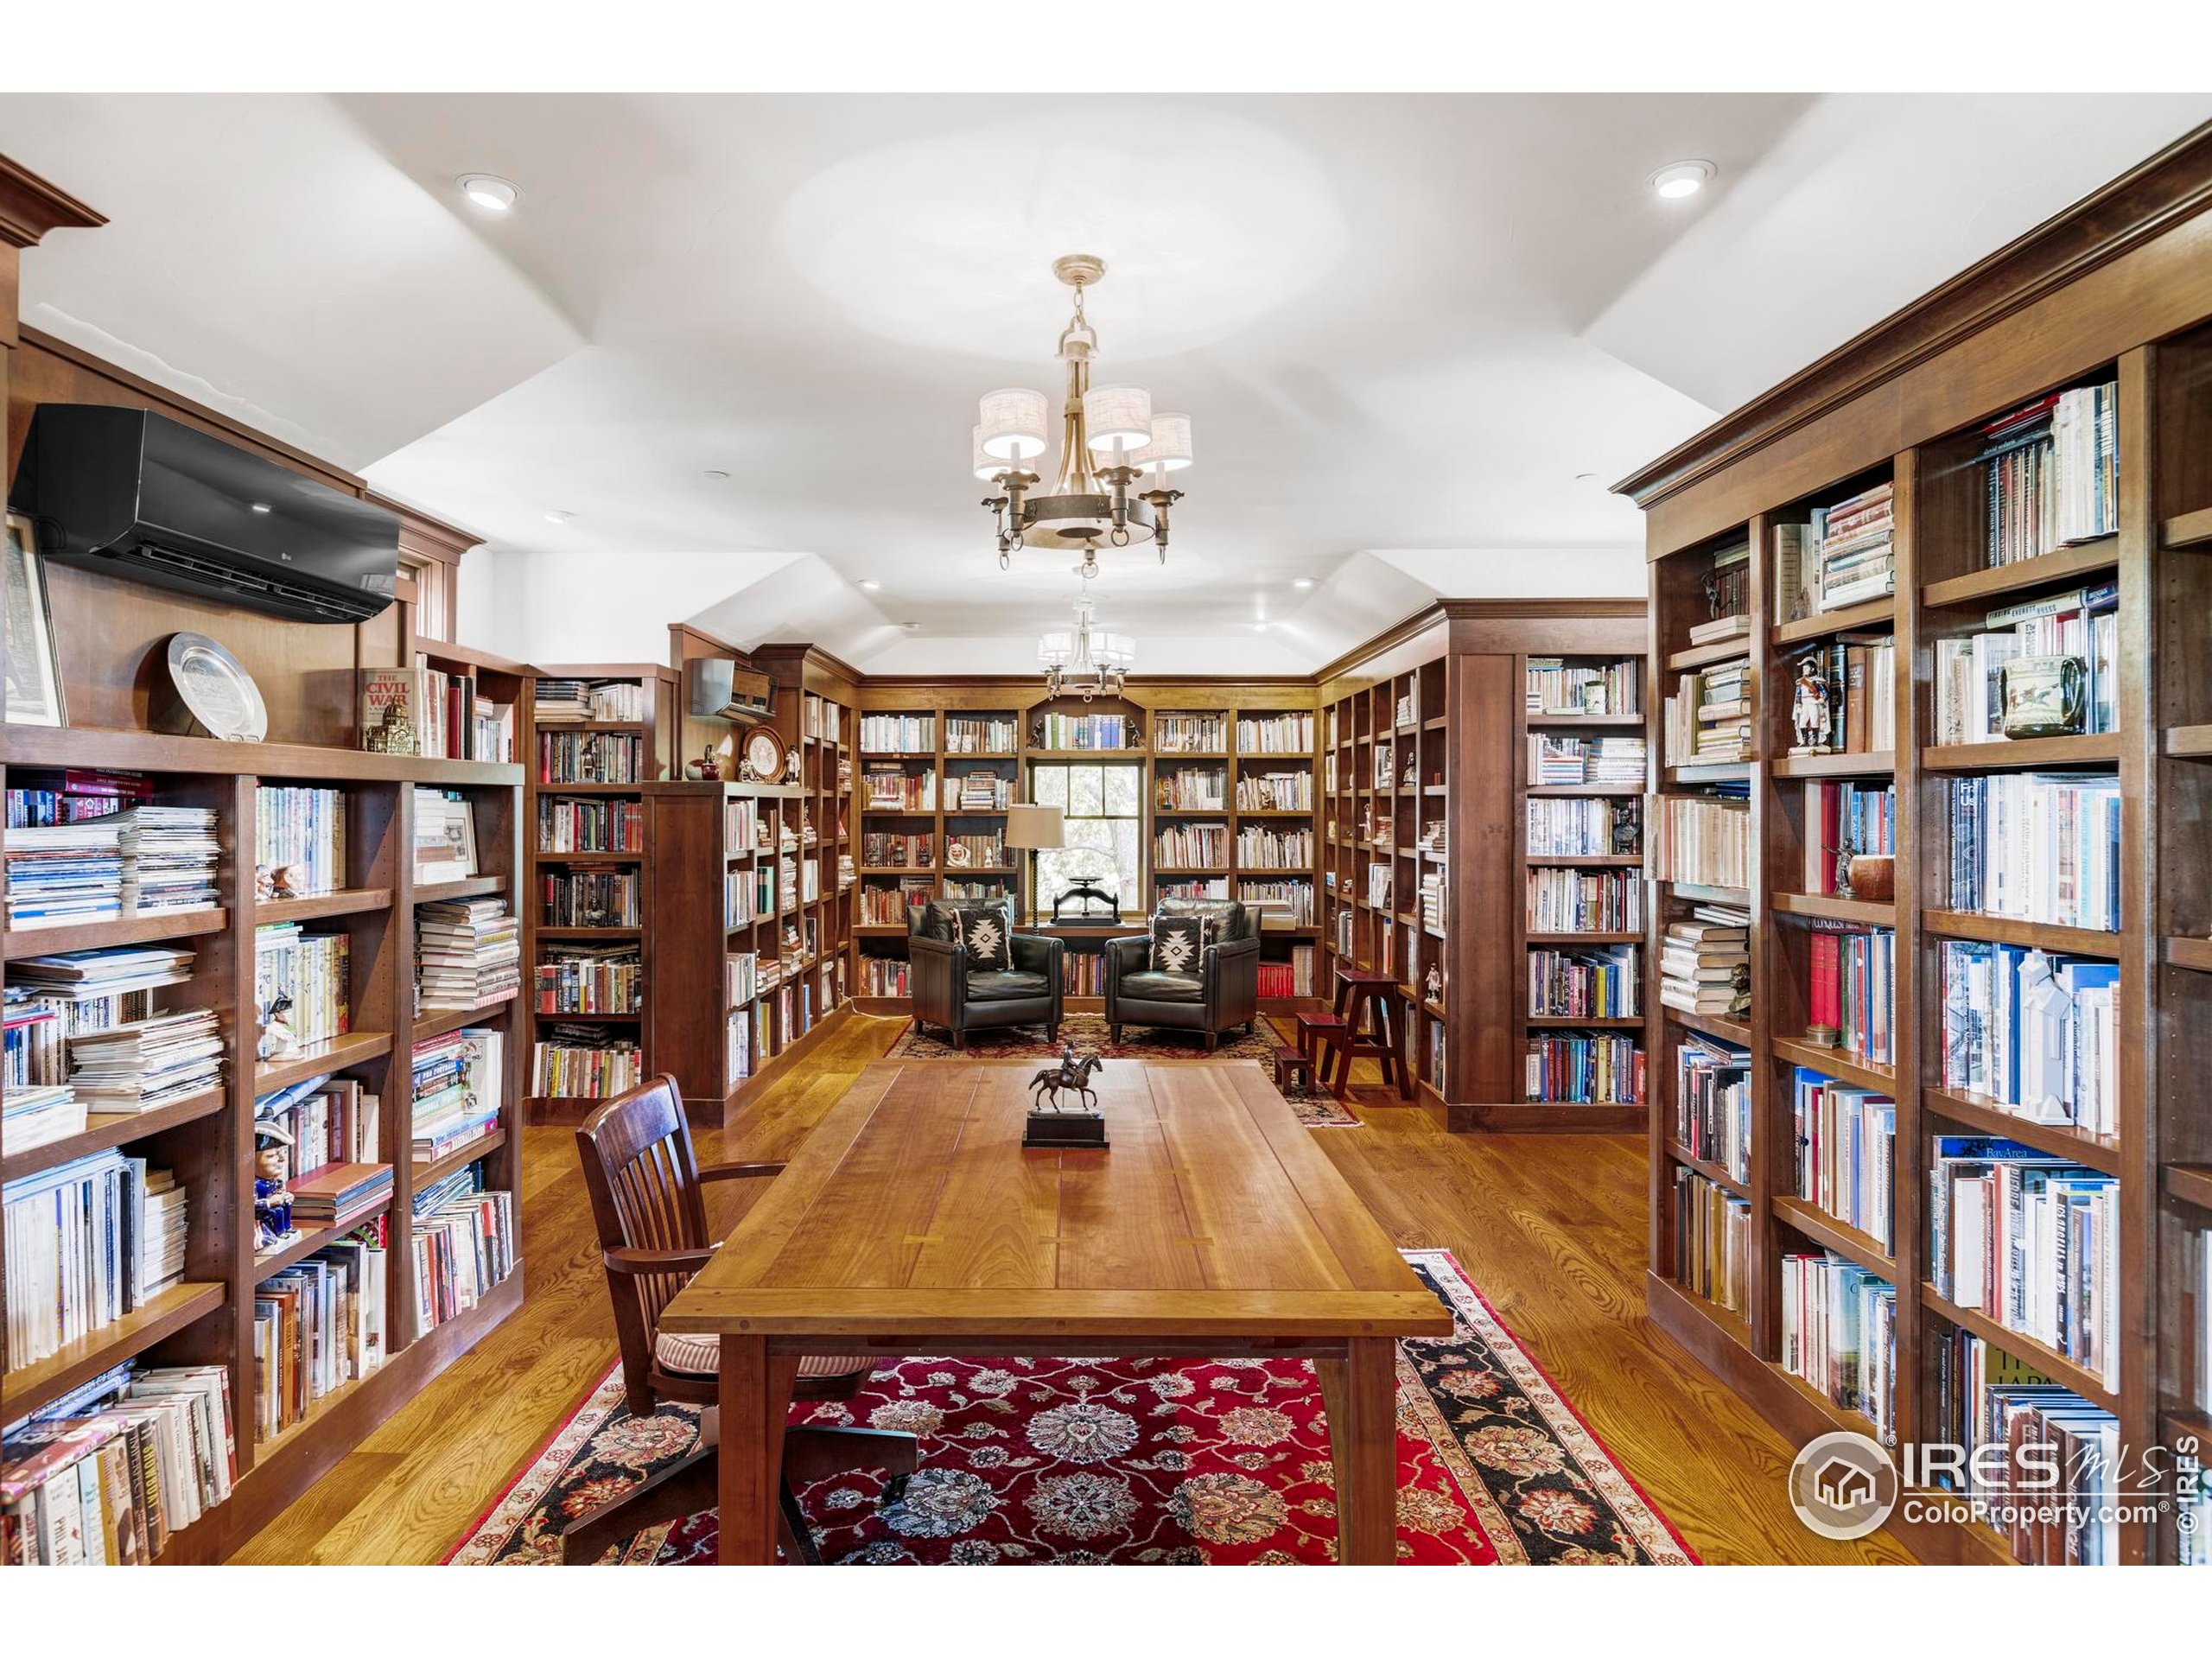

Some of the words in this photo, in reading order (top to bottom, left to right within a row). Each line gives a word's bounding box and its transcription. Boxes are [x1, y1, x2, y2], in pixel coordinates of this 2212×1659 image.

[365, 683, 410, 694] CIVIL
[367, 694, 409, 706] WAR
[2056, 1203, 2066, 1219] LOS
[2056, 1219, 2066, 1260] ANGELES
[143, 1443, 160, 1510] SHOWBOAT
